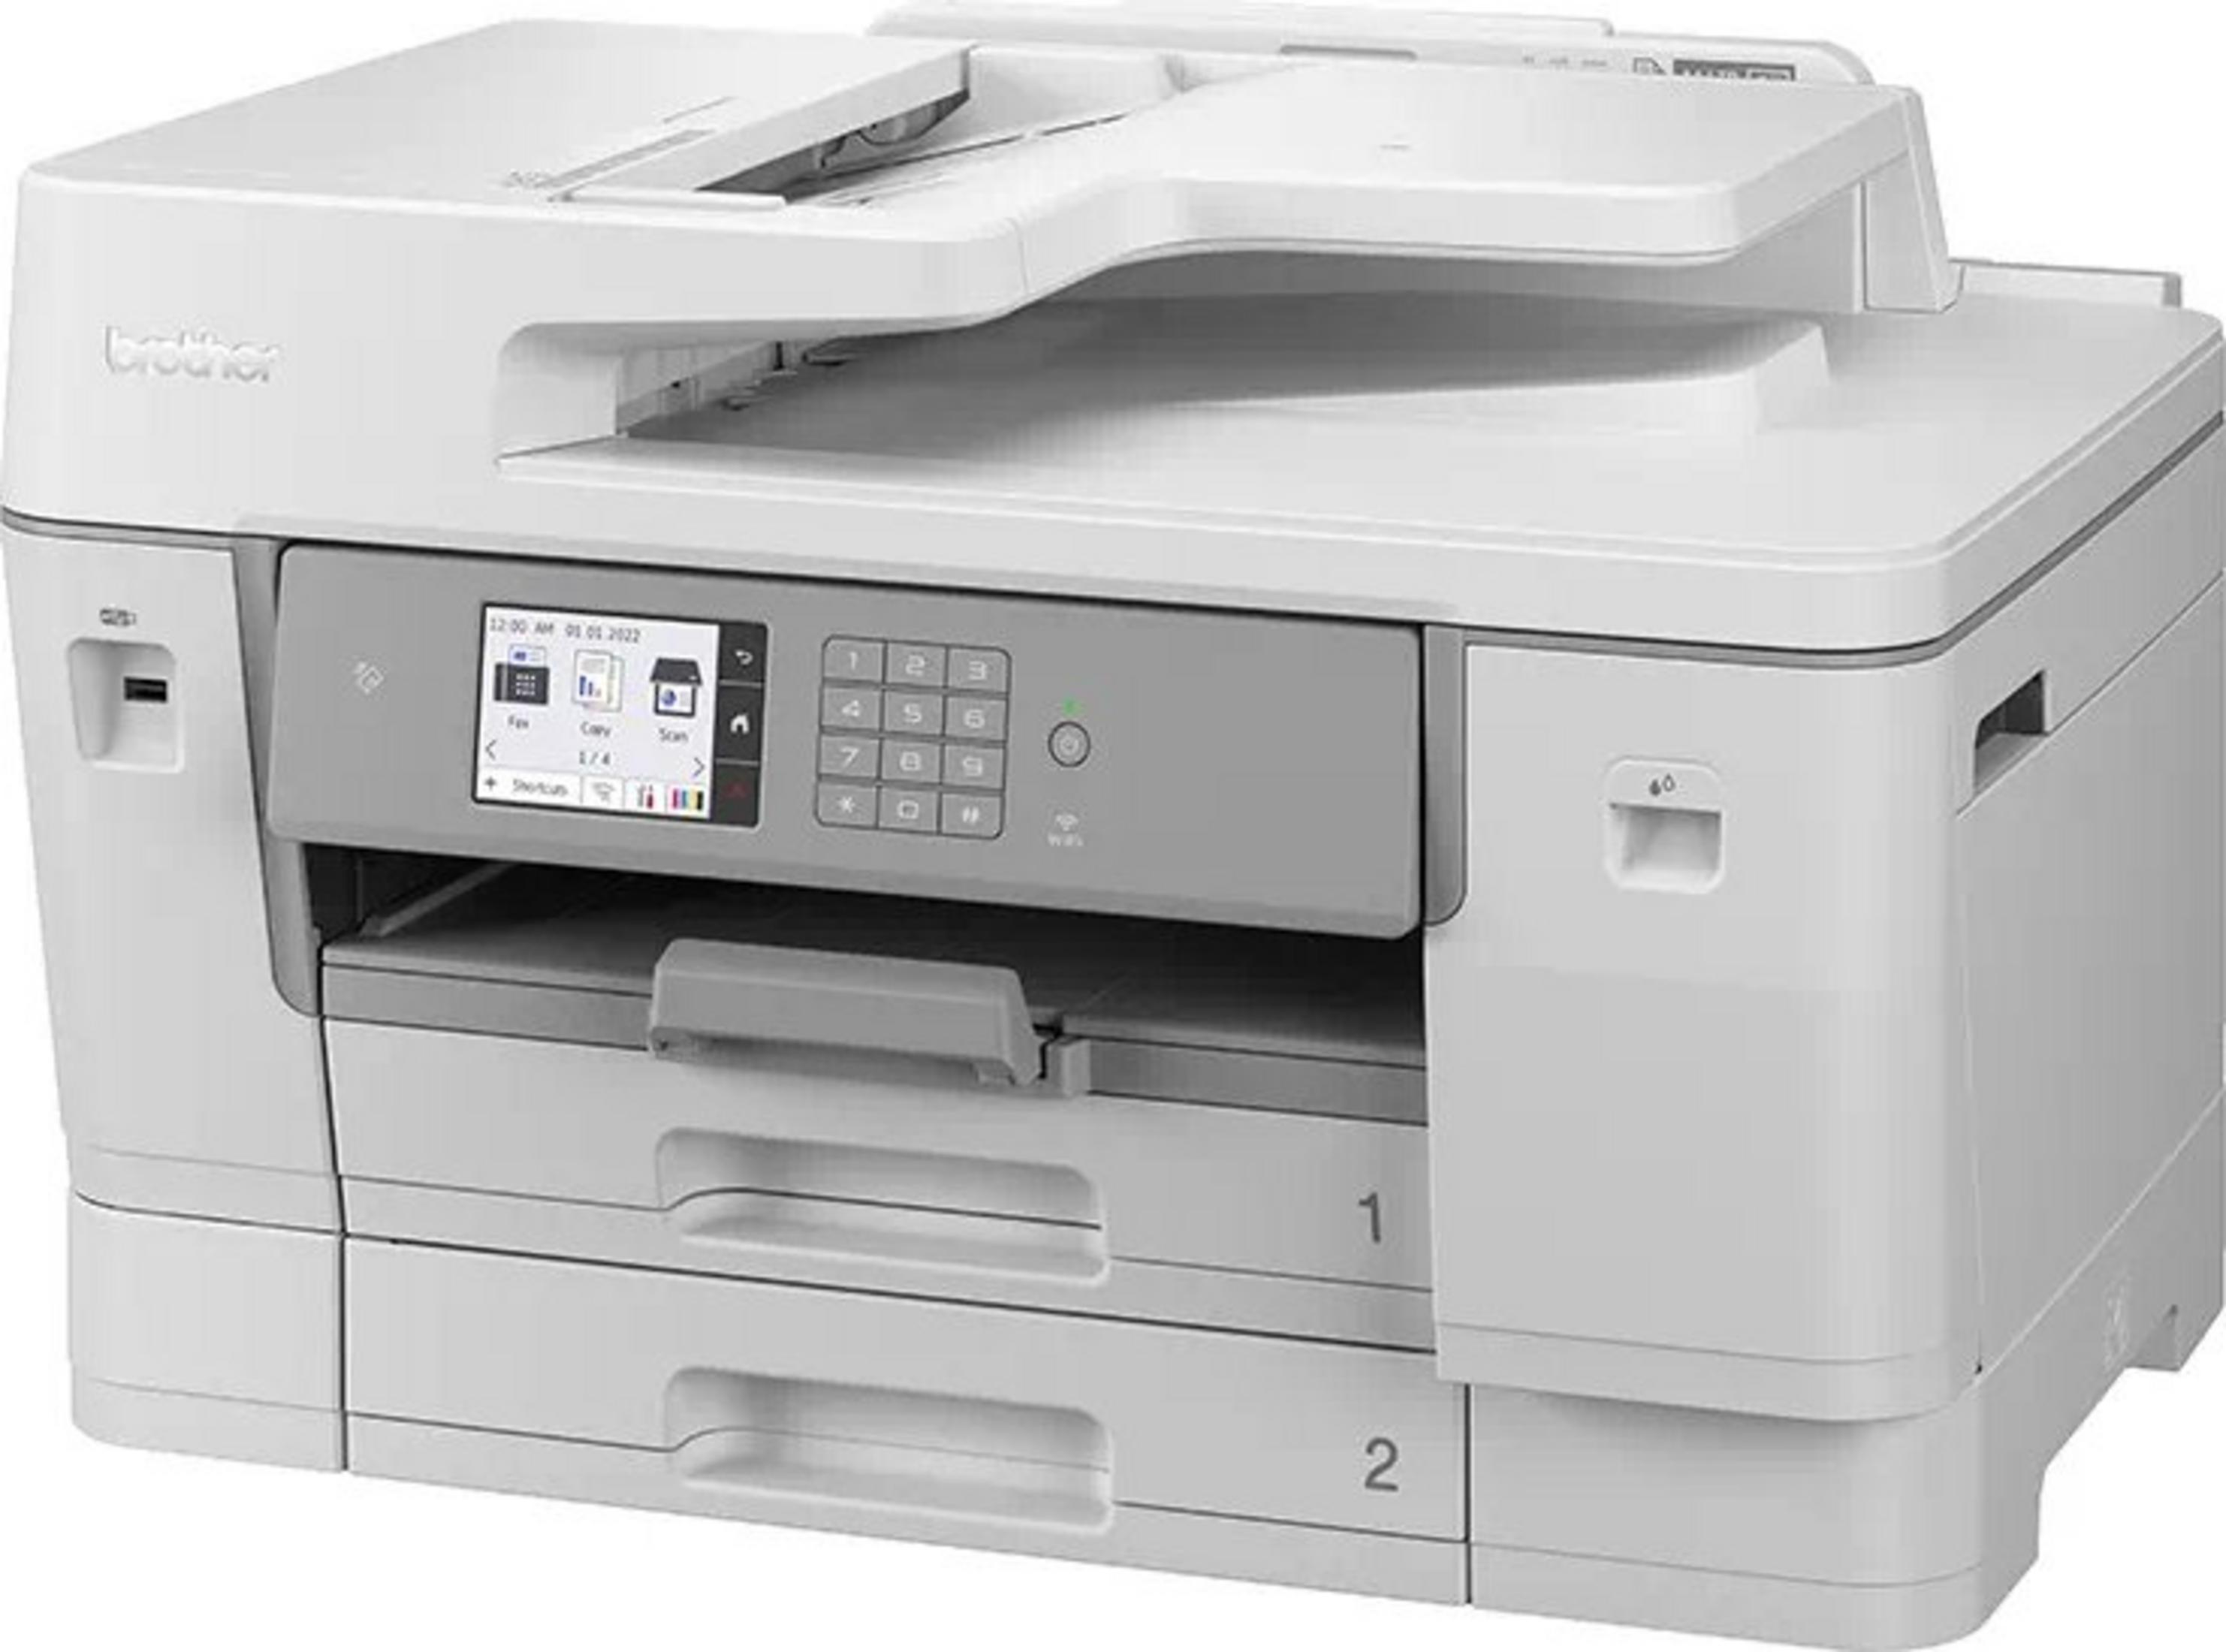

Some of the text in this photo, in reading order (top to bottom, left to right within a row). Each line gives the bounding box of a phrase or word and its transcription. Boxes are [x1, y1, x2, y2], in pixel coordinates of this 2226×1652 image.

[104, 325, 280, 381] brother
[534, 622, 555, 635] AM
[849, 651, 987, 680] 1 2 3
[841, 699, 985, 729] 4 5 6
[658, 727, 689, 743] Scan
[840, 746, 983, 777] 7 8 9
[512, 779, 569, 796] Shortcuts
[897, 799, 920, 820] 0
[1358, 1192, 1382, 1244] 1
[1364, 1437, 1399, 1493] 2
